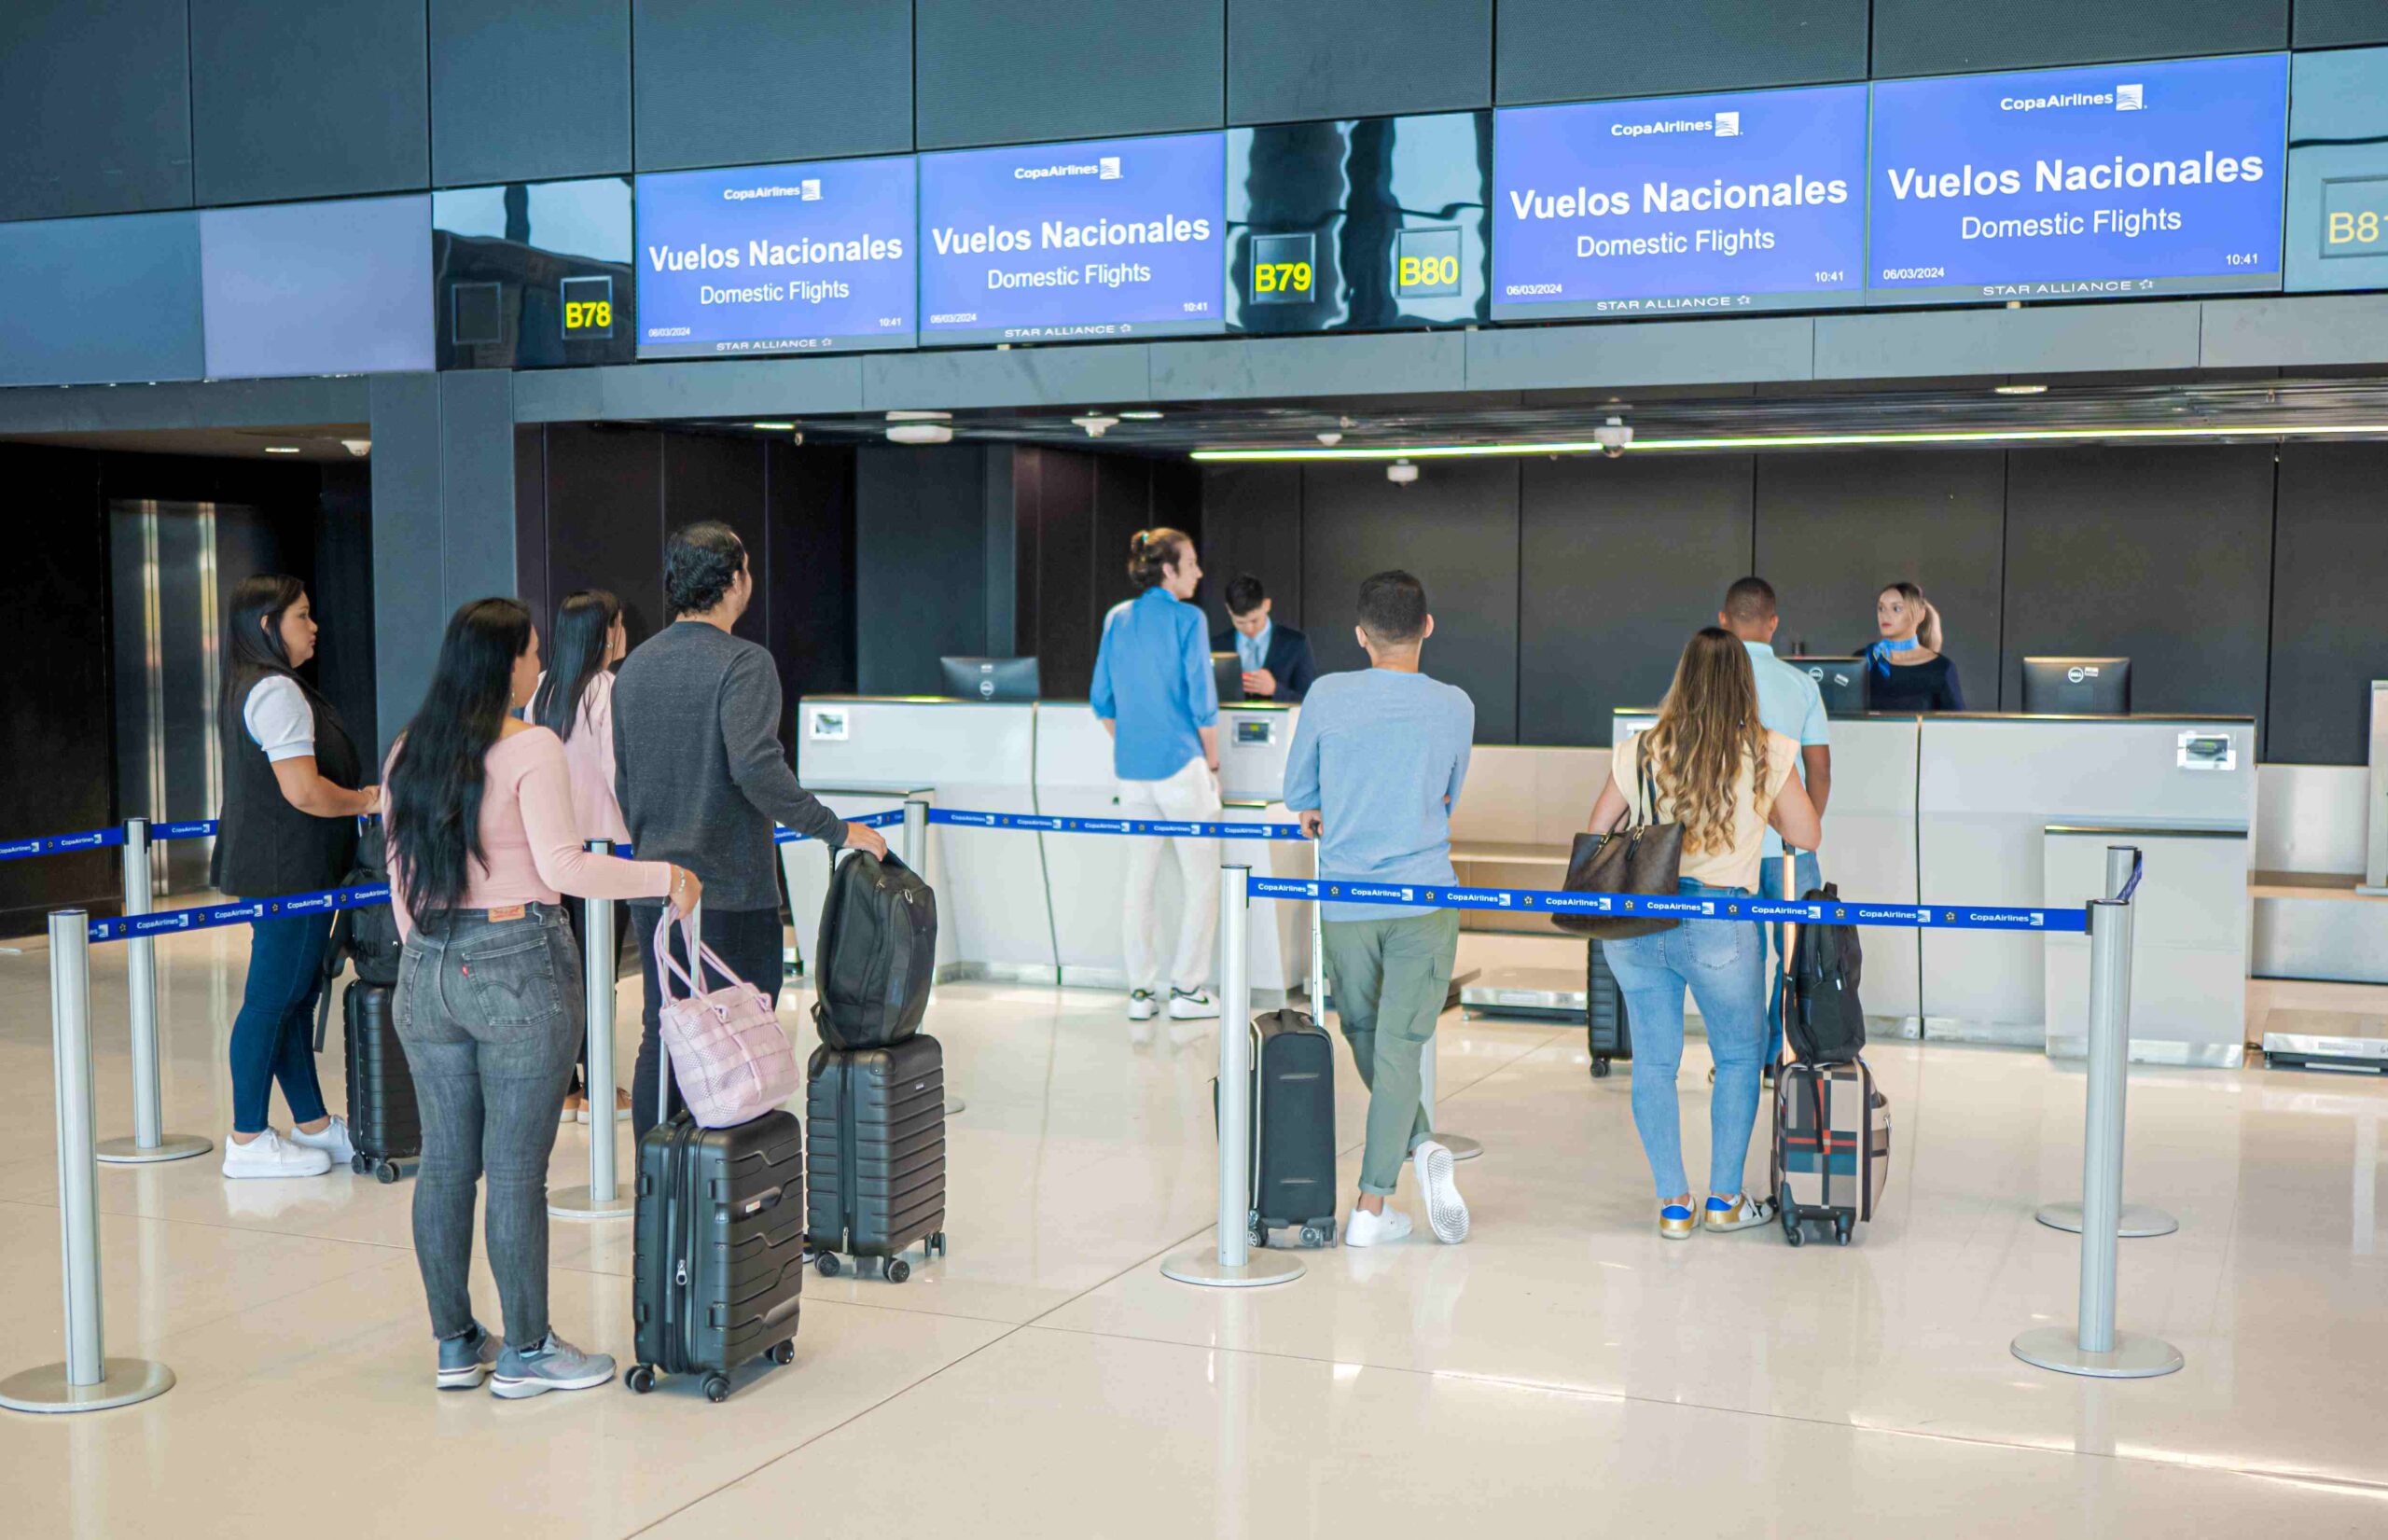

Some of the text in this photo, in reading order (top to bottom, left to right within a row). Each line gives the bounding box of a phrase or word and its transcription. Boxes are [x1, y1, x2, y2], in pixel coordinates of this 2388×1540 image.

[2001, 94, 2113, 111] CopaAirlines
[1611, 121, 1712, 136] CopaAirlines
[1015, 165, 1098, 179] CopaAirlines
[1888, 151, 2263, 199] Vuelos Nacionales
[724, 187, 800, 201] CopaAirlines
[1510, 174, 1847, 219] Vuelos Nacionales
[1963, 208, 2181, 239] Domestic Flights
[933, 215, 1210, 254] Vuelos Nacionales
[1577, 229, 1774, 257] Domestic Flights
[649, 234, 902, 271] Vuelos Nacionales
[2227, 254, 2257, 265] 10:41
[989, 263, 1150, 288] Domestic Flights
[1255, 262, 1312, 292] B79
[1399, 256, 1459, 285] B80
[1815, 271, 1842, 282] 10:41
[1883, 268, 1944, 279] 06/03/2024
[701, 281, 849, 304] Domestic Flights
[1506, 284, 1562, 295] 06/03/2024
[1983, 281, 2131, 296] STAR ALLIANCE
[1184, 302, 1207, 312] 10:41
[1597, 297, 1729, 311] STAR ALLIANCE
[565, 301, 611, 328] B78
[880, 318, 901, 326] 10:41
[1005, 326, 1115, 337] STAR ALLIANCE
[716, 340, 817, 351] STAR ALLIANCE
[1258, 883, 1917, 920] CopaAirlines CopaAirlines CopaAirlines CopaAirlines CopaAirlines CopaAirlines CopaAirlines
[136, 917, 178, 930] CopaAirlines
[215, 907, 254, 919] CopaAirlines
[287, 898, 324, 909] CopaAirlines
